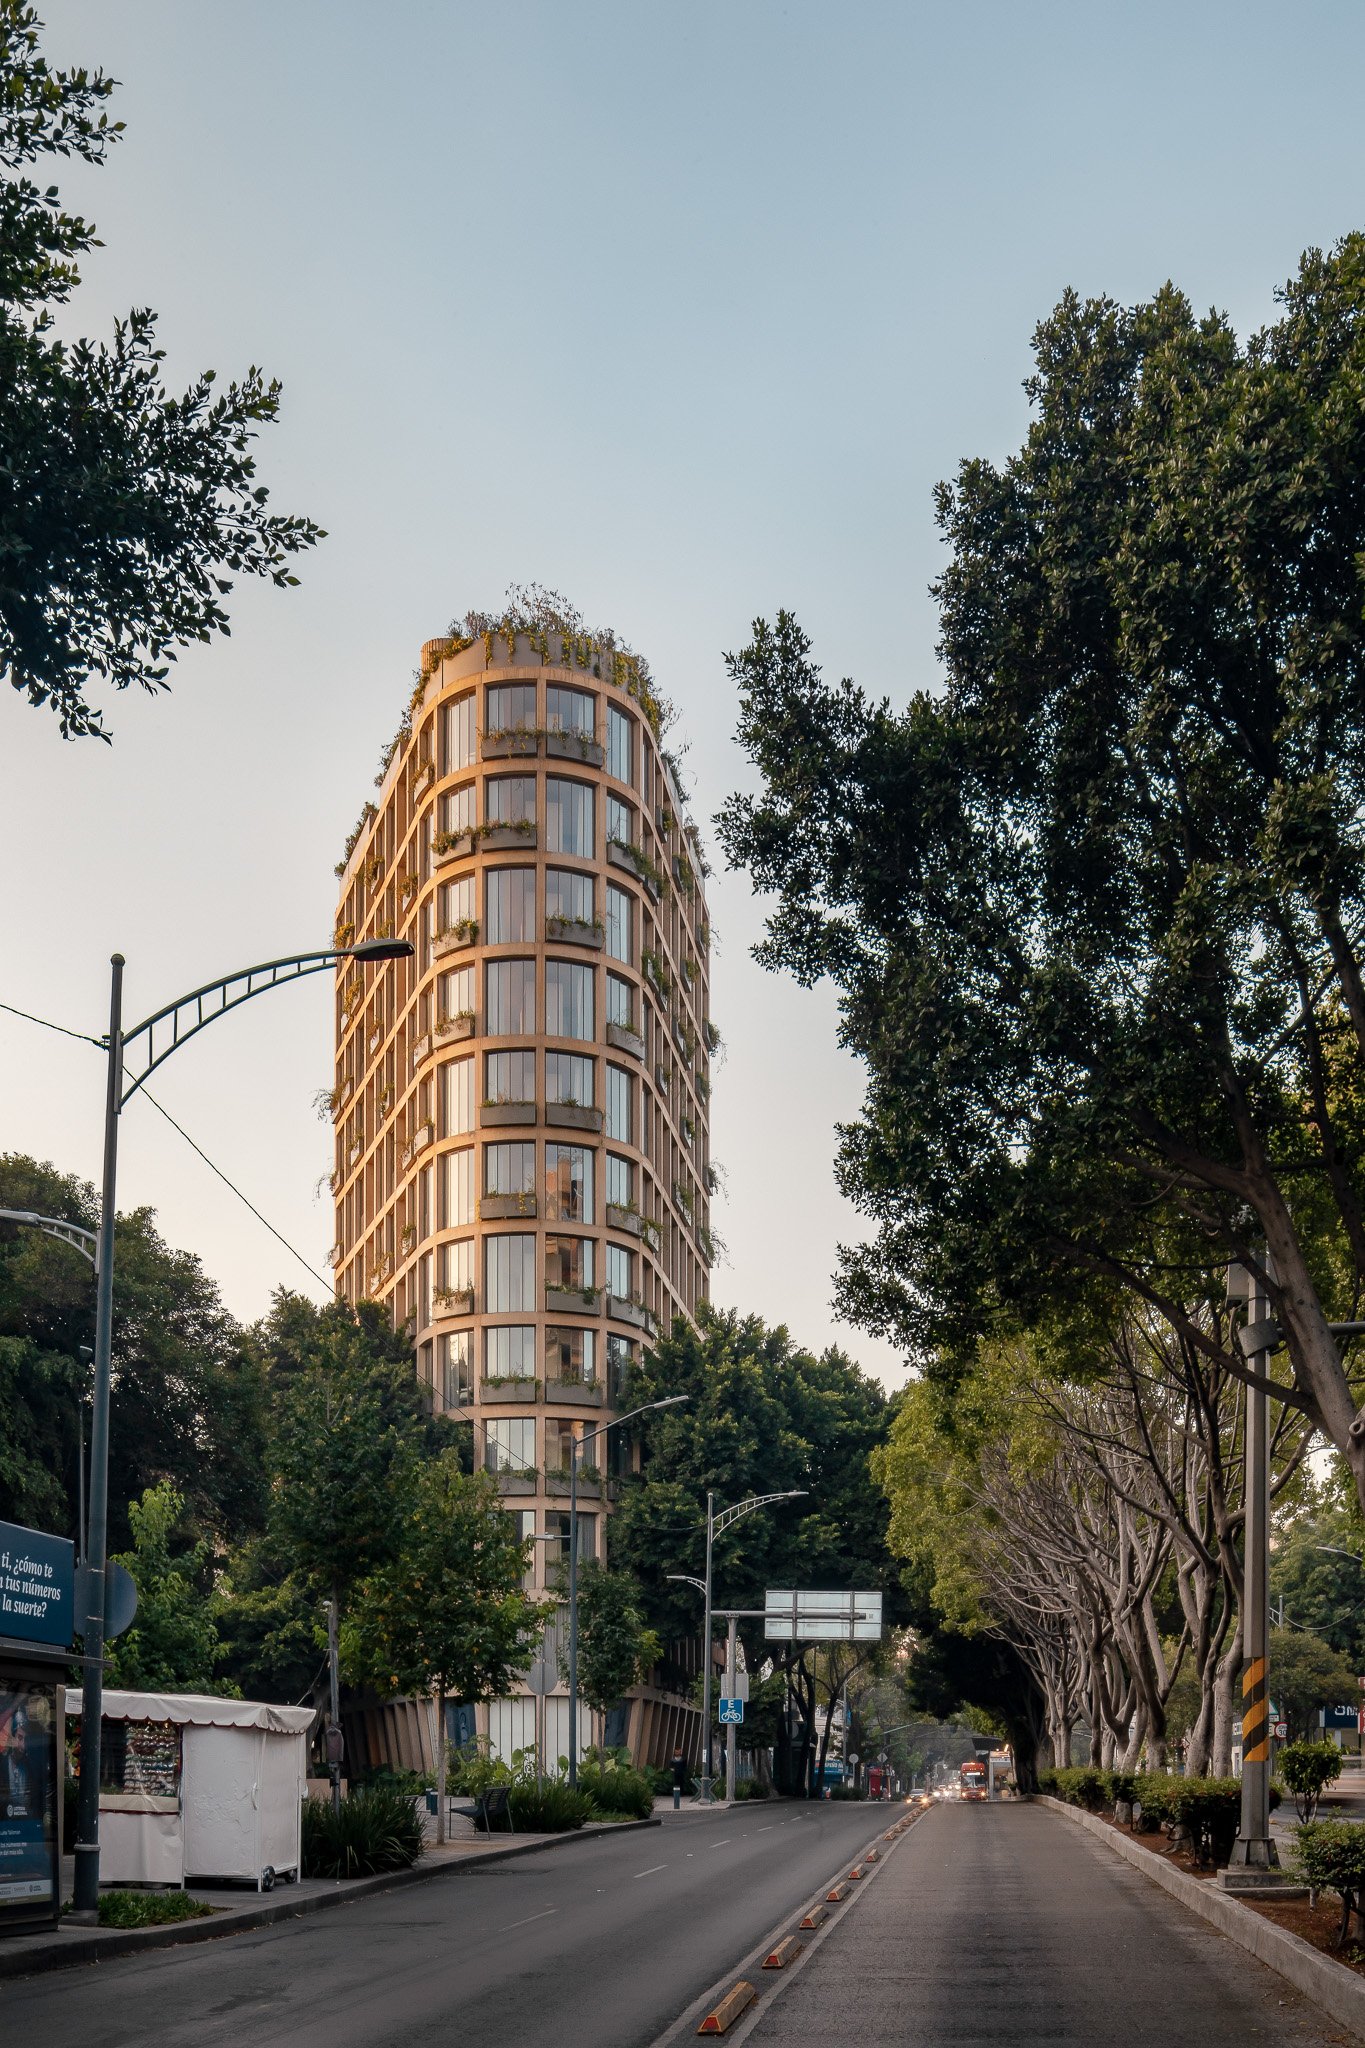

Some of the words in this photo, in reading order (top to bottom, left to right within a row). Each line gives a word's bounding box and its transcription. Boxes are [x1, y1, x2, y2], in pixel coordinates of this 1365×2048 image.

[1, 1551, 12, 1572] ti,
[13, 1555, 43, 1576] ¿cómo
[44, 1563, 53, 1578] te
[5, 1575, 21, 1592] tus
[22, 1577, 61, 1601] números
[2, 1593, 12, 1612] la
[13, 1600, 47, 1618] suerte?
[727, 1699, 735, 1709] E
